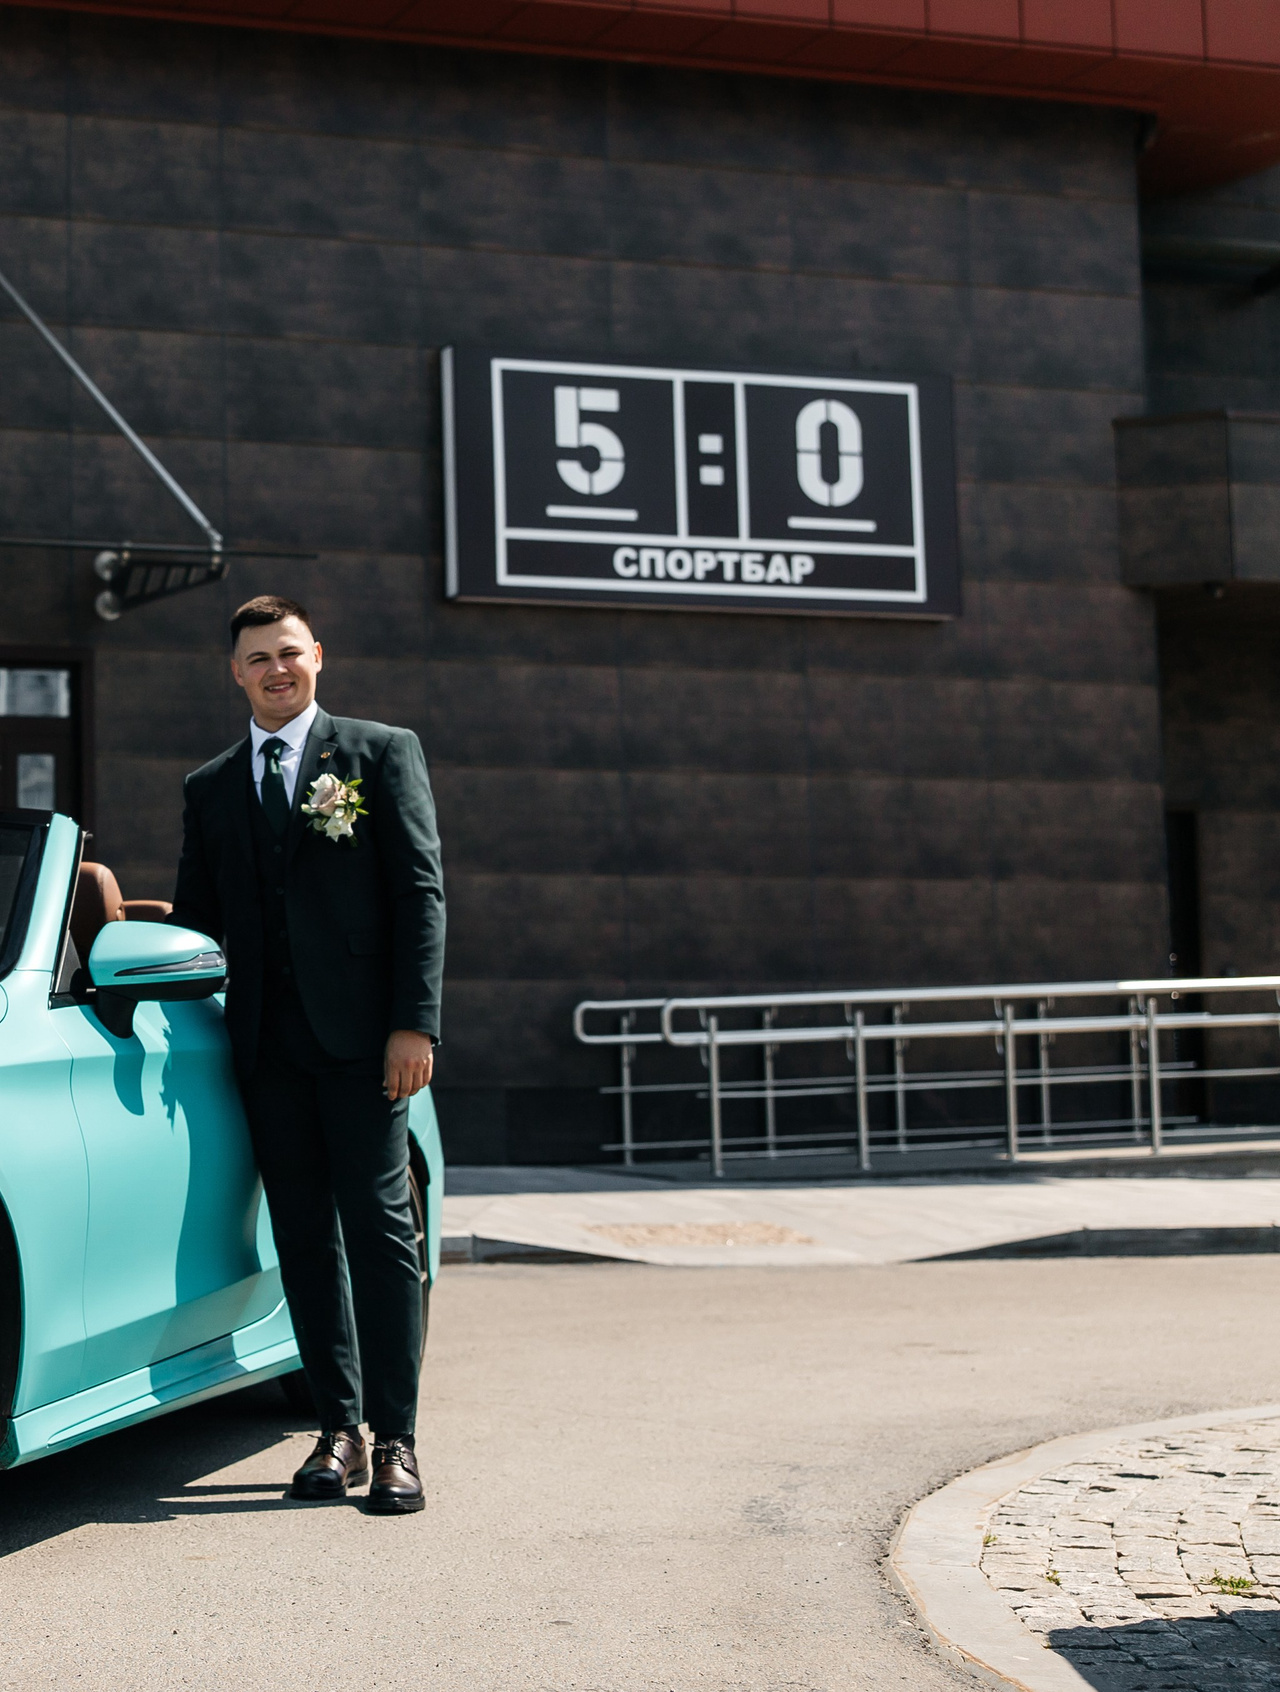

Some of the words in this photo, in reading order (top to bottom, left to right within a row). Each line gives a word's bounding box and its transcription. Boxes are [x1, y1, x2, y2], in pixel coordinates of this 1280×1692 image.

[554, 385, 625, 495] 5
[795, 398, 864, 507] 0
[612, 547, 815, 584] СПОРТБАР
